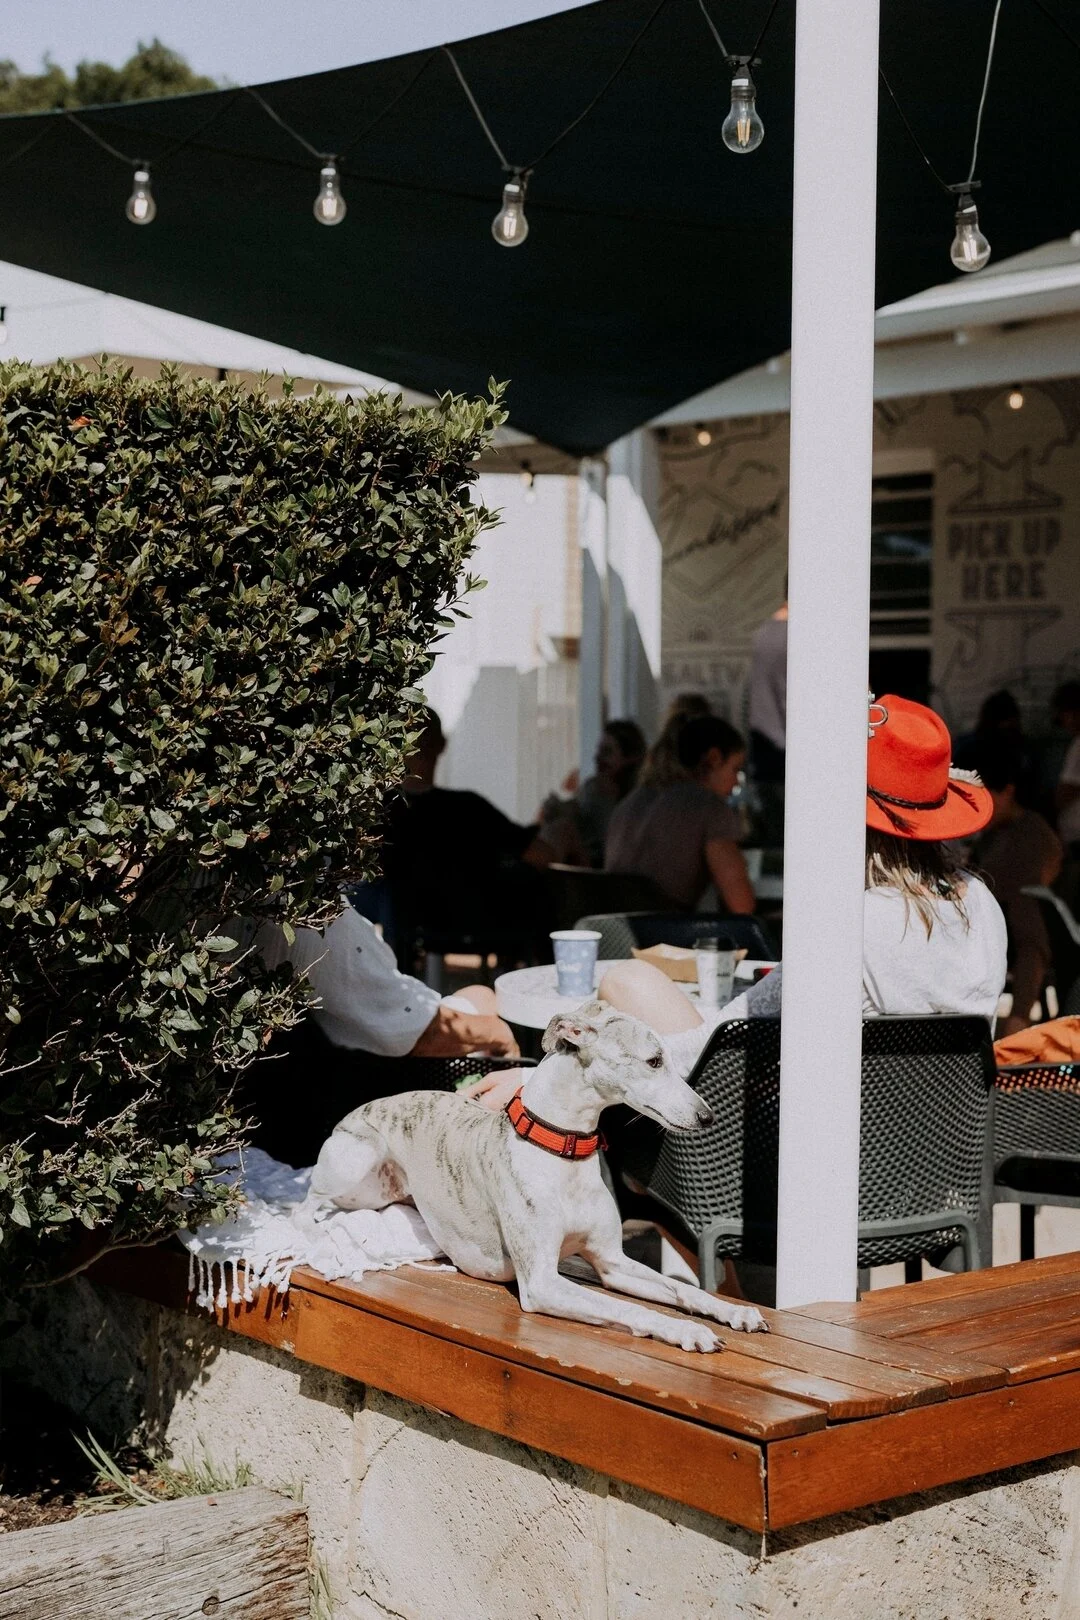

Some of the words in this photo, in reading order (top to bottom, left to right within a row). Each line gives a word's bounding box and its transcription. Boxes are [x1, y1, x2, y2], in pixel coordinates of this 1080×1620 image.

[948, 519, 1011, 560] PICK
[1022, 516, 1062, 556] UP
[961, 561, 1046, 600] HERE
